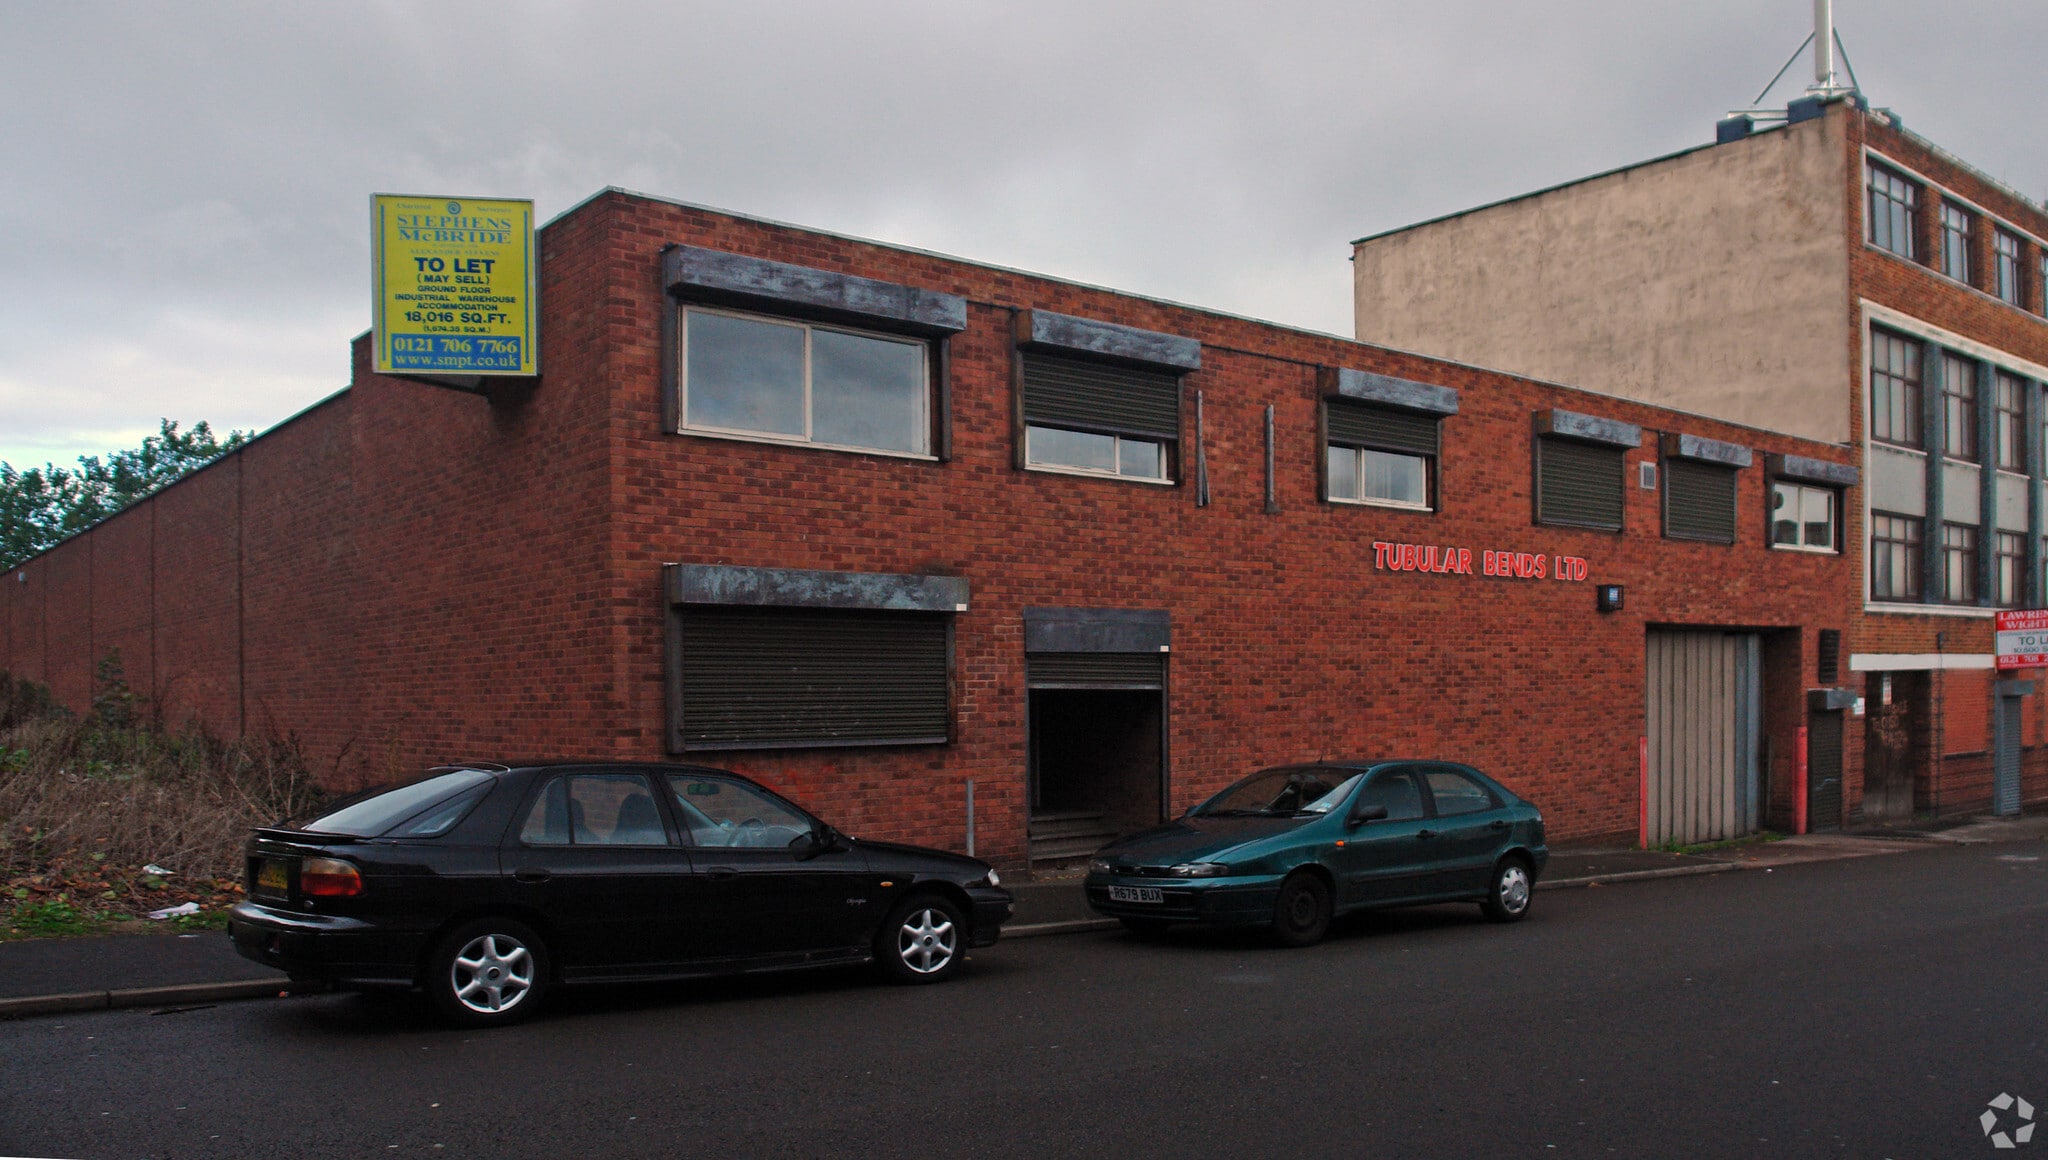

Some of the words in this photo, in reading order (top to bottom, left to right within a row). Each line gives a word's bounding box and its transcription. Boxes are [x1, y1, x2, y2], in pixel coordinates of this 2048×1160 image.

[397, 215, 512, 229] STEPHENS
[398, 229, 512, 244] McBRIDE
[414, 257, 445, 272] TO
[454, 258, 495, 274] LET
[456, 275, 490, 285] SELL)
[417, 285, 457, 293] GROUND
[460, 286, 491, 294] FLOOR
[395, 293, 450, 301] INDUSTRIAL
[458, 295, 516, 303] WAREHOUSE
[416, 302, 498, 311] ACCOMMODATION
[405, 311, 454, 323] 18,016
[460, 312, 511, 324] SQ.FT.
[394, 337, 434, 352] 0121
[440, 338, 472, 353] 706
[477, 339, 518, 353] 7766
[395, 354, 518, 368] www.smpt.co.uk
[1373, 542, 1473, 575] TUBULAR
[1483, 550, 1546, 579] BENDS
[1555, 556, 1588, 581] LTD
[2018, 636, 2036, 646] TO
[2040, 635, 2048, 645] L
[1113, 886, 1139, 900] R679
[1140, 888, 1162, 901] BUX
